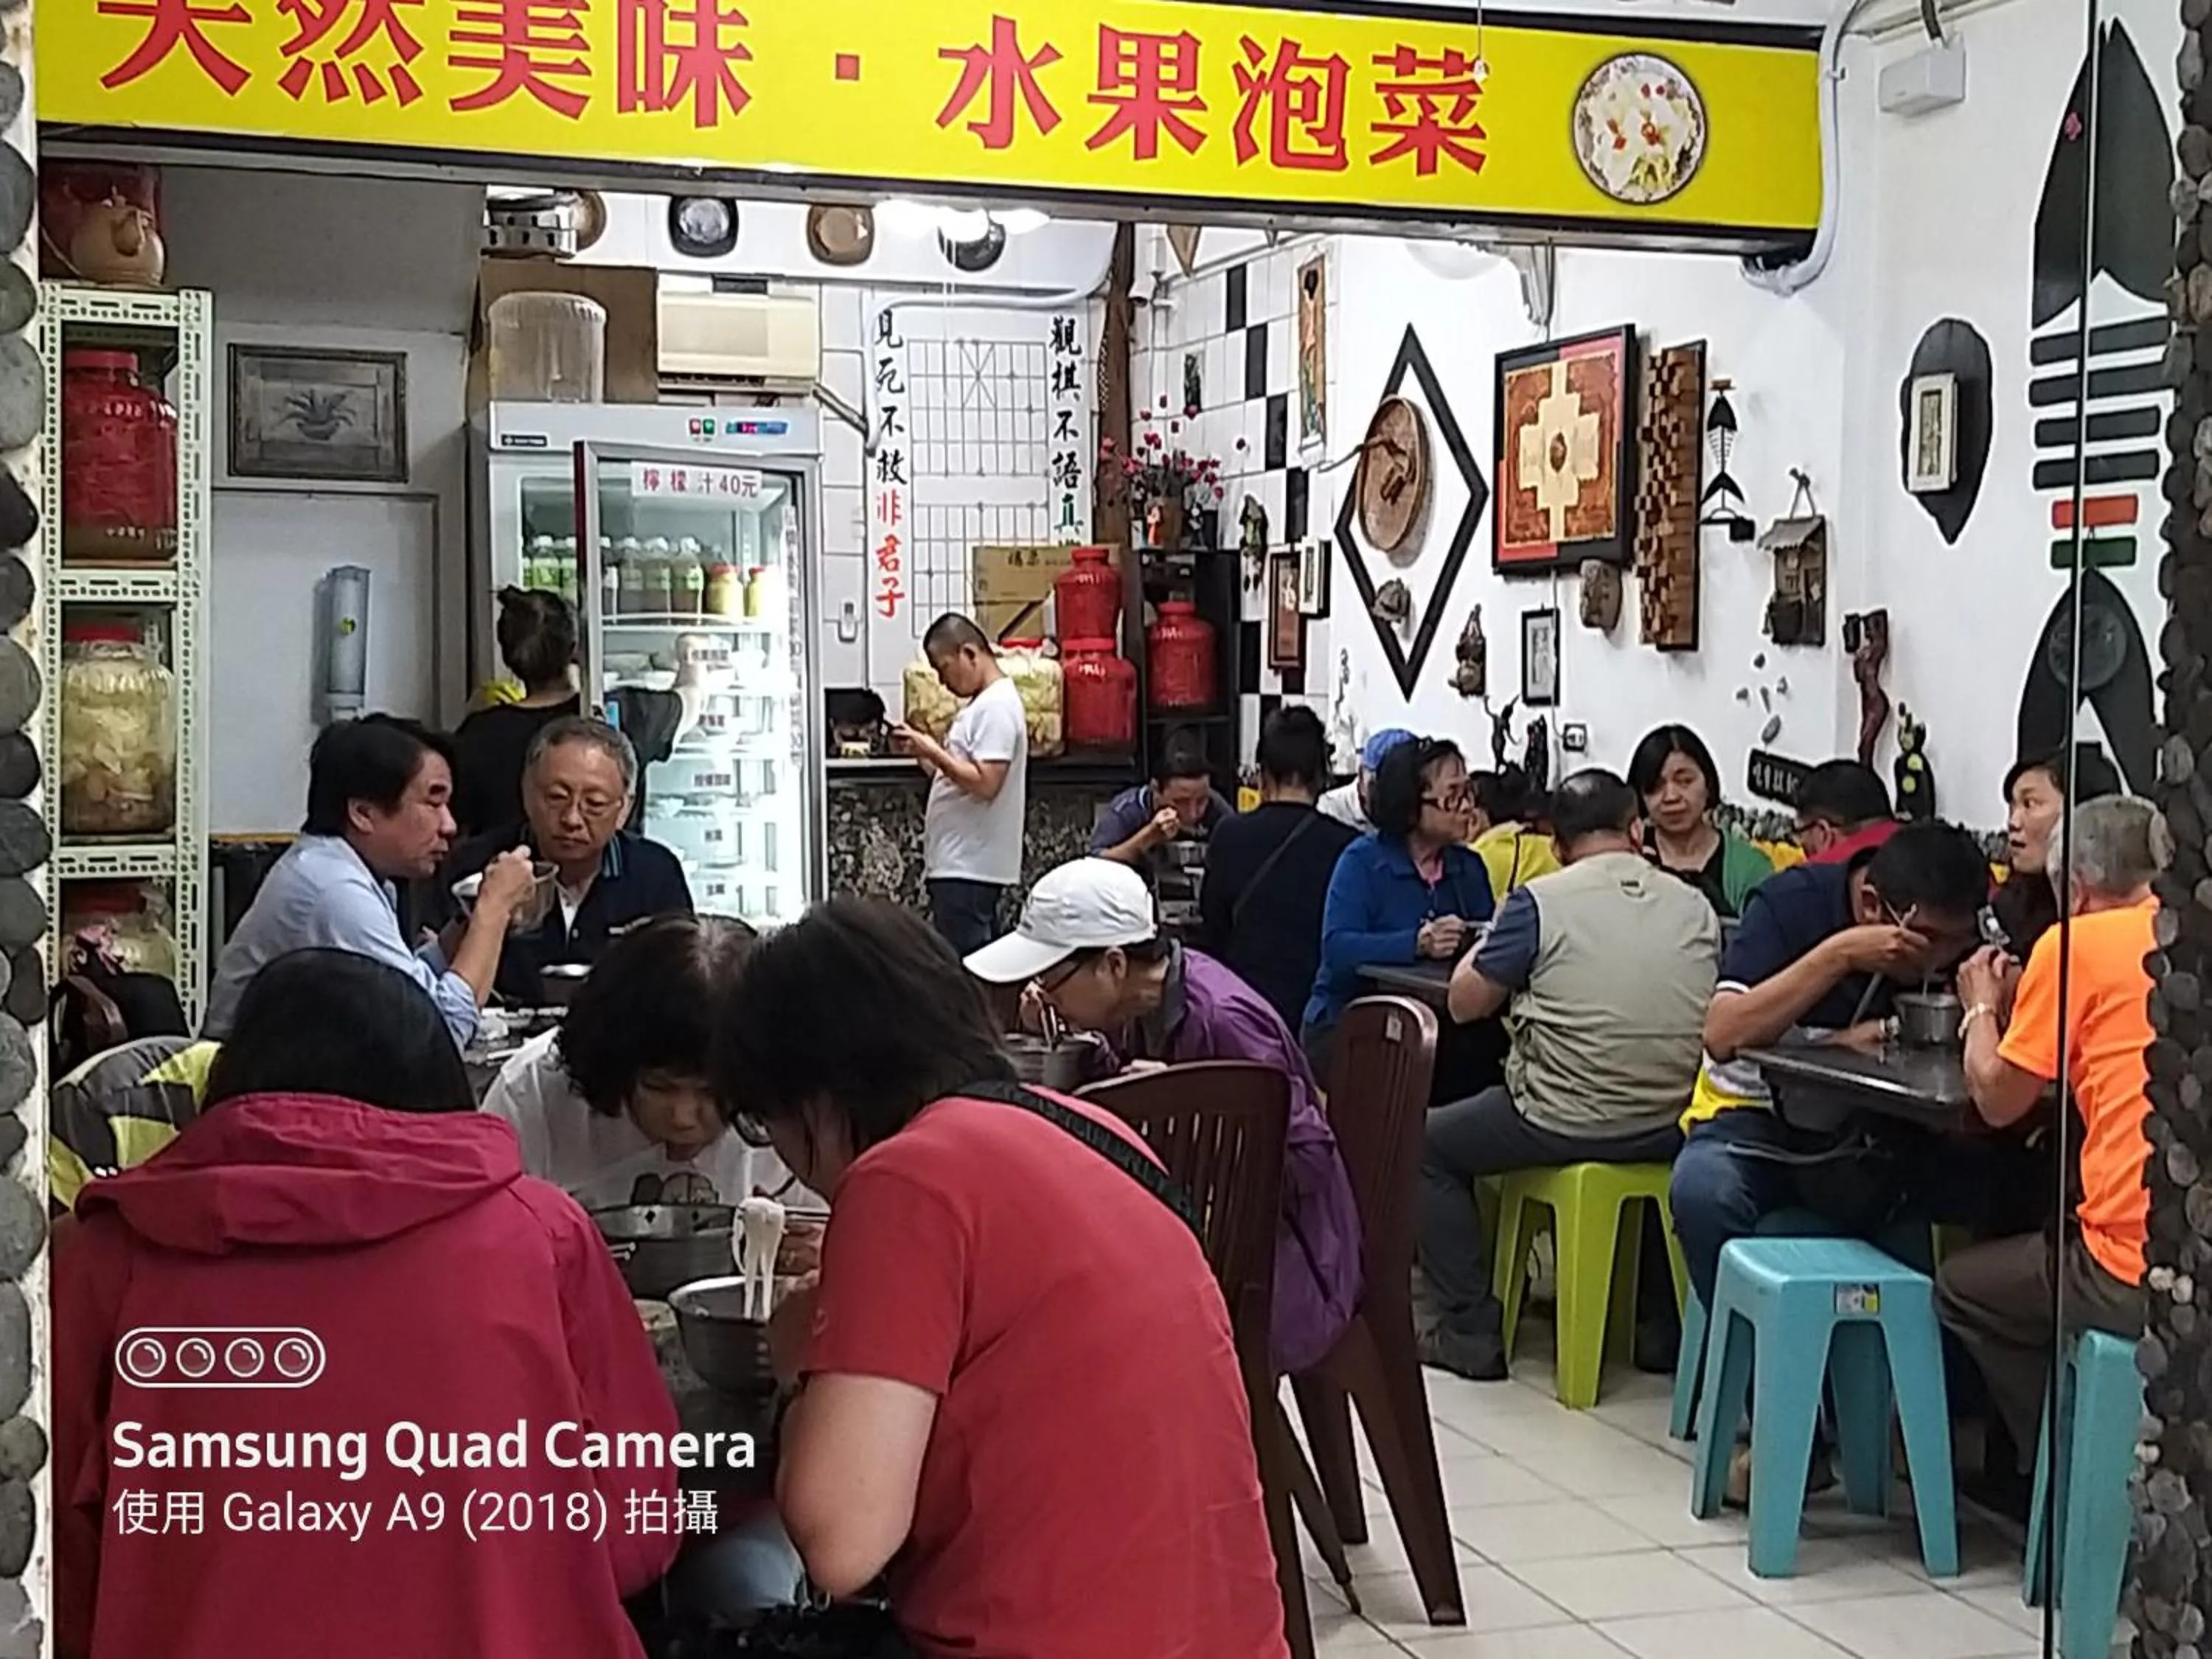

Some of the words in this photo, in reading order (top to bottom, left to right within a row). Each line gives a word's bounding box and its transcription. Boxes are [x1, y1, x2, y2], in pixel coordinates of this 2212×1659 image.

[937, 18, 1486, 176] 水果泡菜
[1049, 316, 1084, 546] 觀棋不語真
